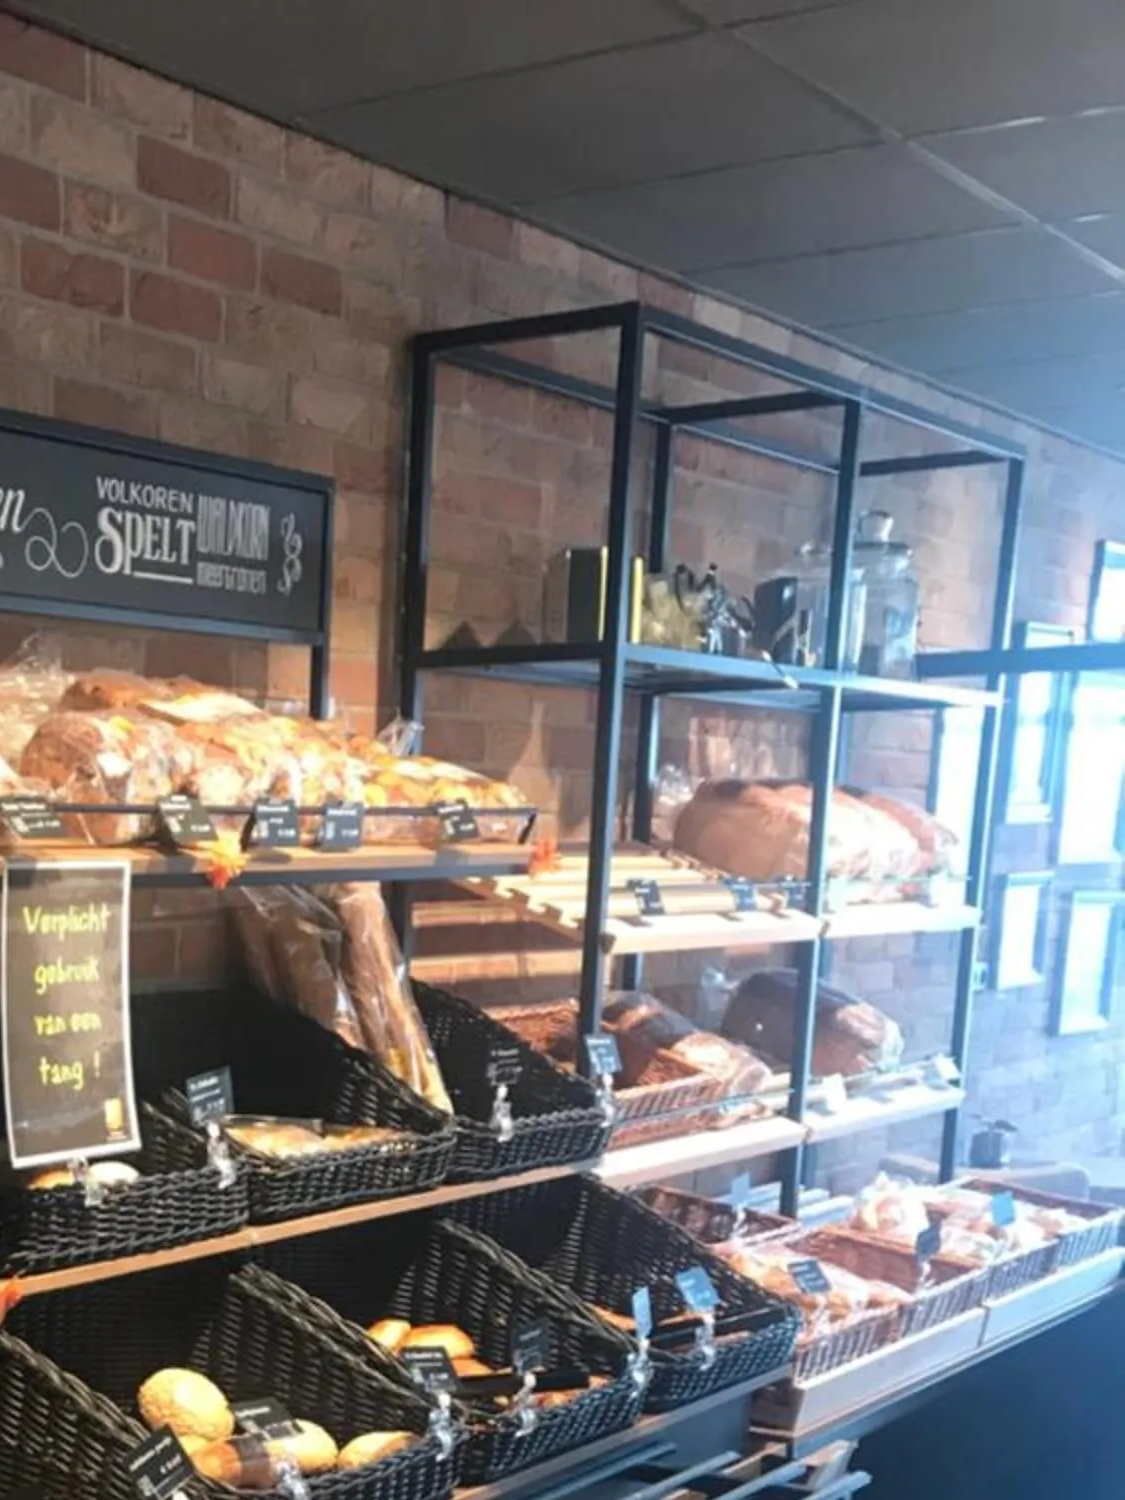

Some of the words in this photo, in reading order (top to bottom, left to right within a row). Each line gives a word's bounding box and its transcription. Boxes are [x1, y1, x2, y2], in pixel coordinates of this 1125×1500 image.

[96, 475, 195, 514] VOLKOREN
[94, 506, 197, 575] SPELT
[22, 902, 112, 942] Verplicht
[34, 956, 101, 996] gebruik
[39, 1056, 84, 1090] tang
